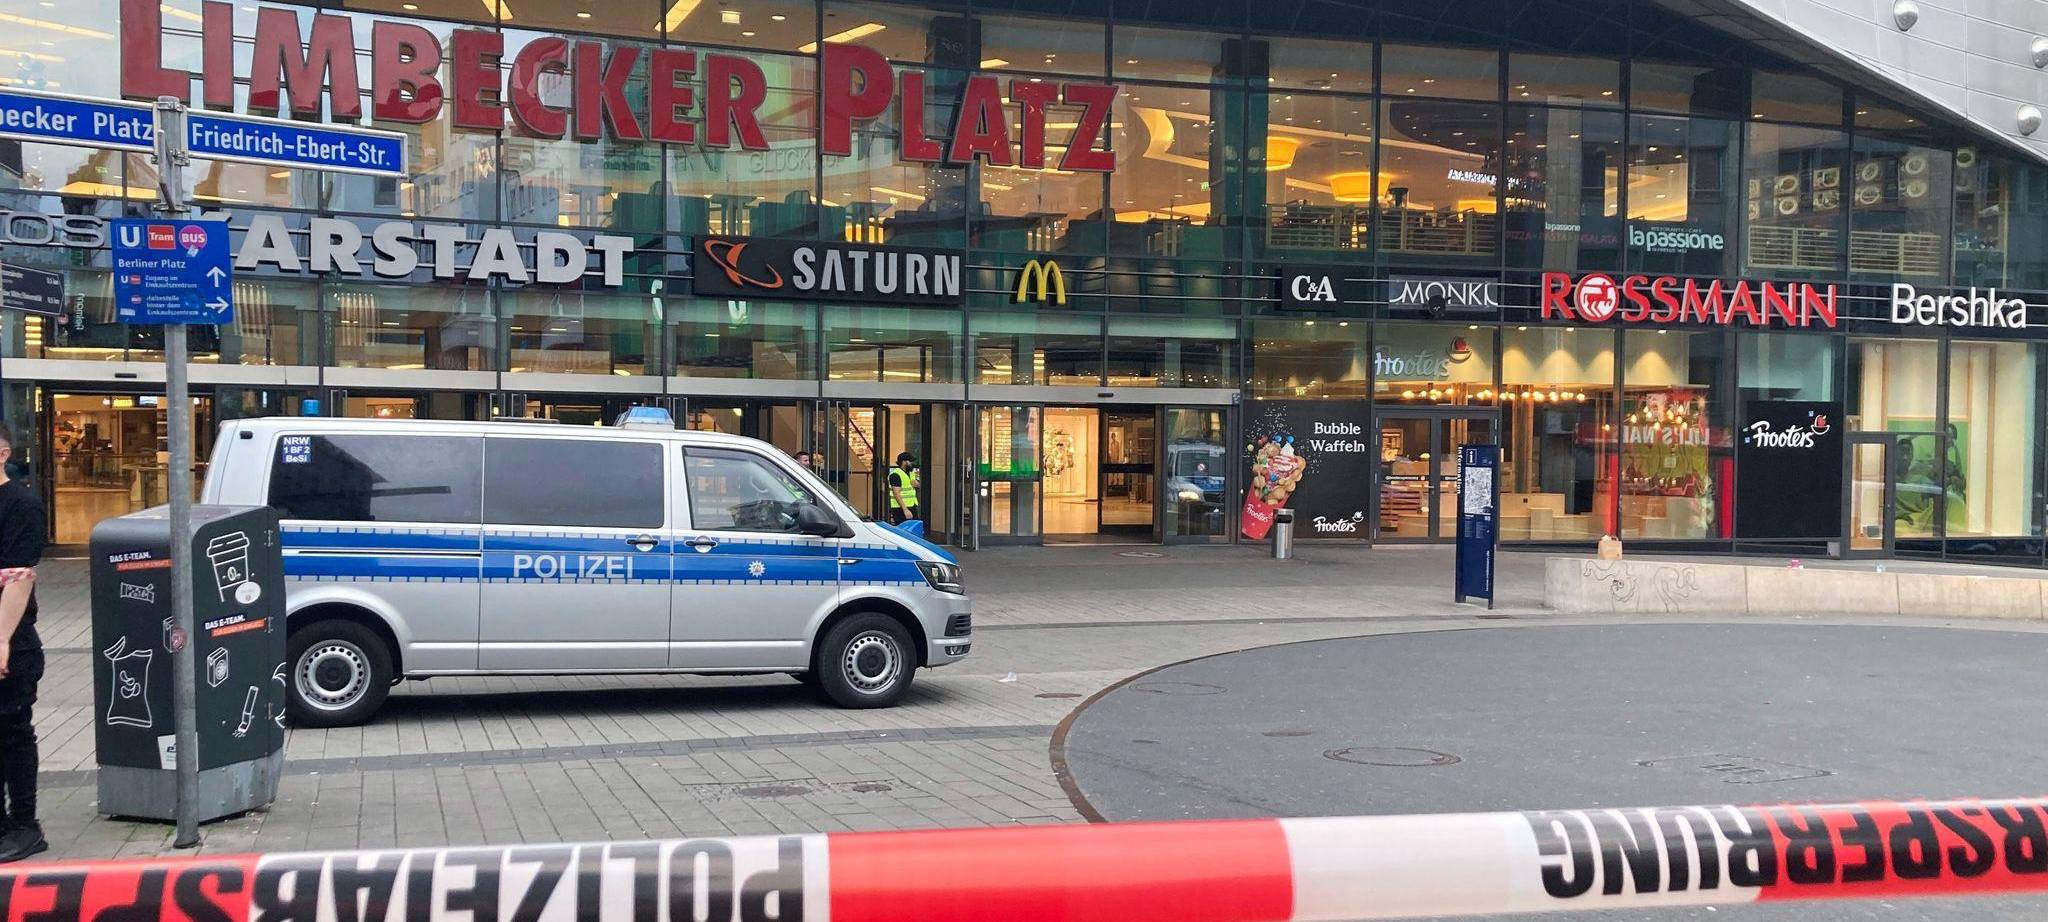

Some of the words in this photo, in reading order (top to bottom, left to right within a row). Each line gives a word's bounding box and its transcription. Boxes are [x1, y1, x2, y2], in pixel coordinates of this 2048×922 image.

[120, 0, 770, 151] LIMBECKER
[820, 42, 1120, 172] PLATZ
[93, 111, 154, 140] Platz
[191, 122, 390, 166] Friedrich-Ebert-Str.
[120, 226, 140, 247] U
[149, 232, 174, 241] Tram
[181, 232, 206, 243] BUS
[203, 212, 634, 287] ARSTADT
[118, 259, 158, 269] Berliner
[161, 259, 187, 269] Platz
[792, 247, 960, 297] SATURN
[1291, 275, 1337, 301] C&A
[1389, 280, 1499, 306] MONKI
[1540, 270, 1837, 329] ROSSMANN
[1890, 283, 2028, 329] Bershka
[283, 436, 310, 445] NRW
[1314, 422, 1361, 435] Bubble
[1750, 420, 1815, 448] Frooters
[283, 446, 289, 454] 1
[290, 446, 303, 454] BF
[304, 446, 310, 454] 2
[1309, 440, 1365, 452] Waffeln
[1313, 516, 1357, 532] Frooters
[109, 554, 123, 563] DAS
[123, 551, 152, 562] E-TEAM.
[513, 554, 633, 579] POLIZEI
[204, 620, 219, 630] DAS
[219, 614, 246, 627] E-TEAM.
[0, 836, 803, 922] POLIZEIABSPE
